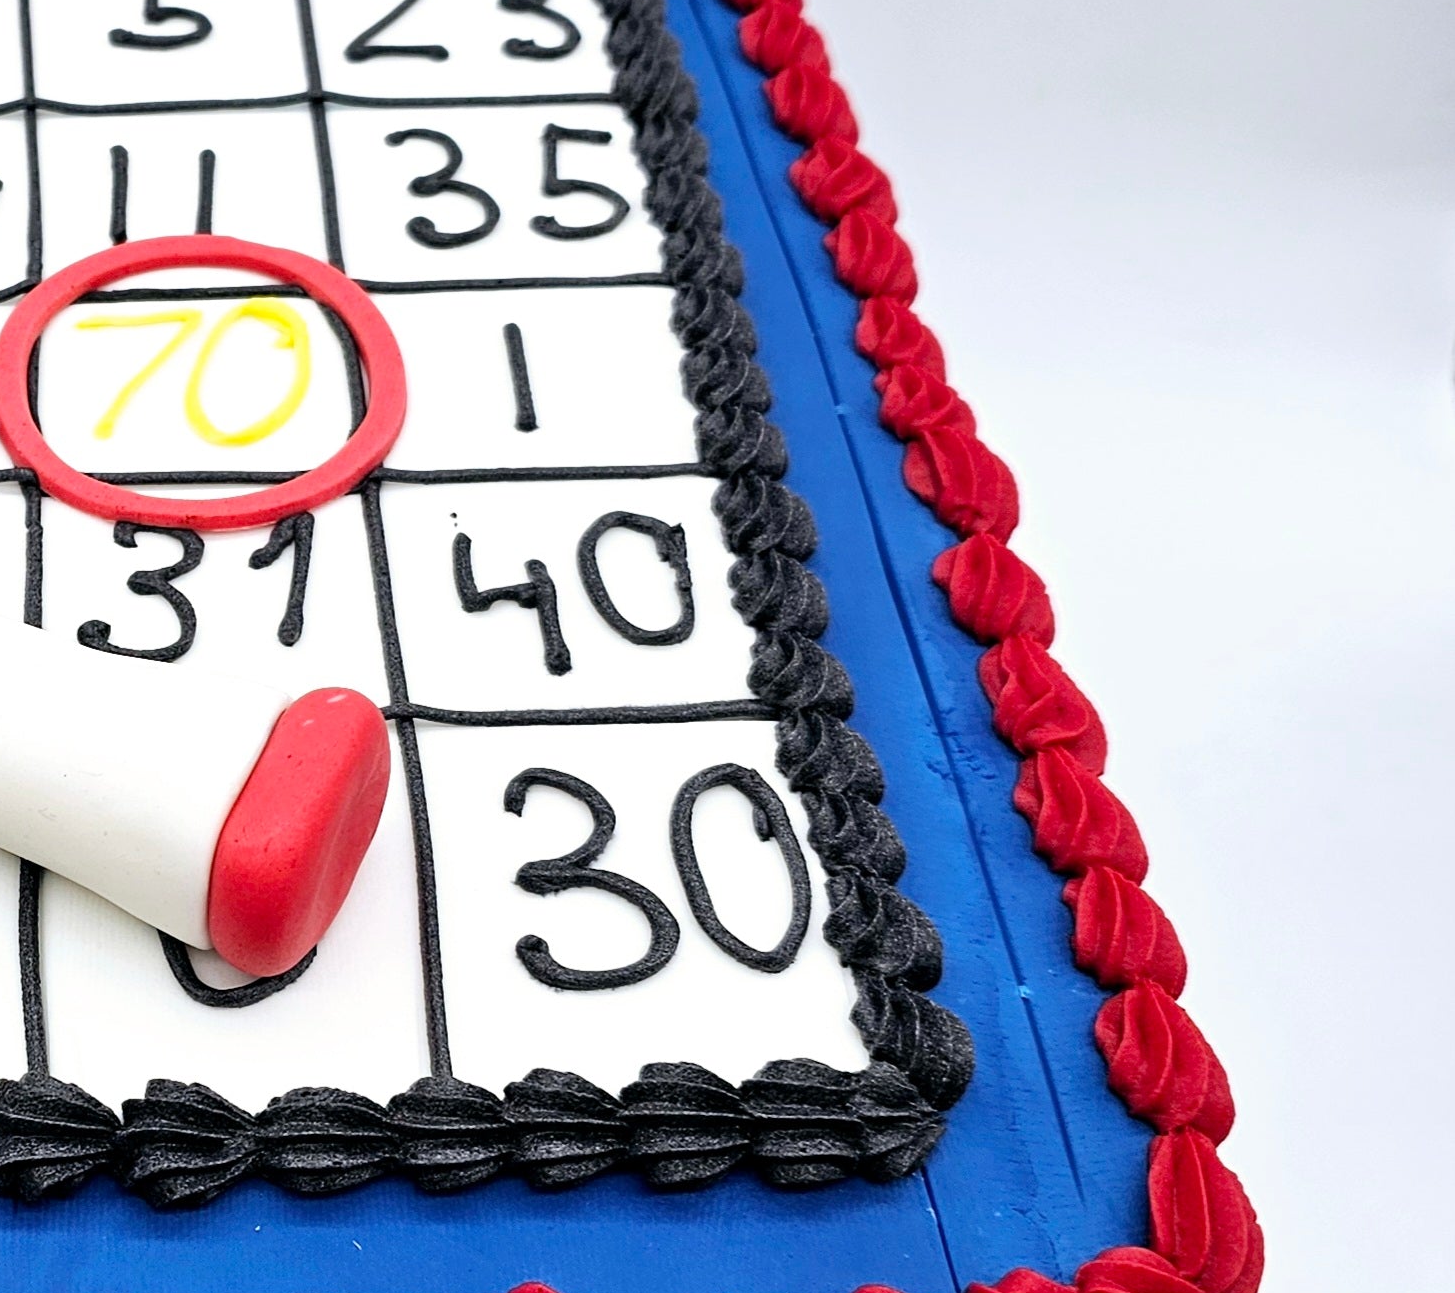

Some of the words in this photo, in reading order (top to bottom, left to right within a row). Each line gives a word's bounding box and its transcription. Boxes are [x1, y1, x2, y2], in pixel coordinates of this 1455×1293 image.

[109, 144, 215, 247] 11
[386, 123, 632, 250] 35
[73, 296, 313, 448] 70
[504, 322, 539, 433] 1
[453, 510, 695, 677] 40
[503, 762, 814, 992] 30
